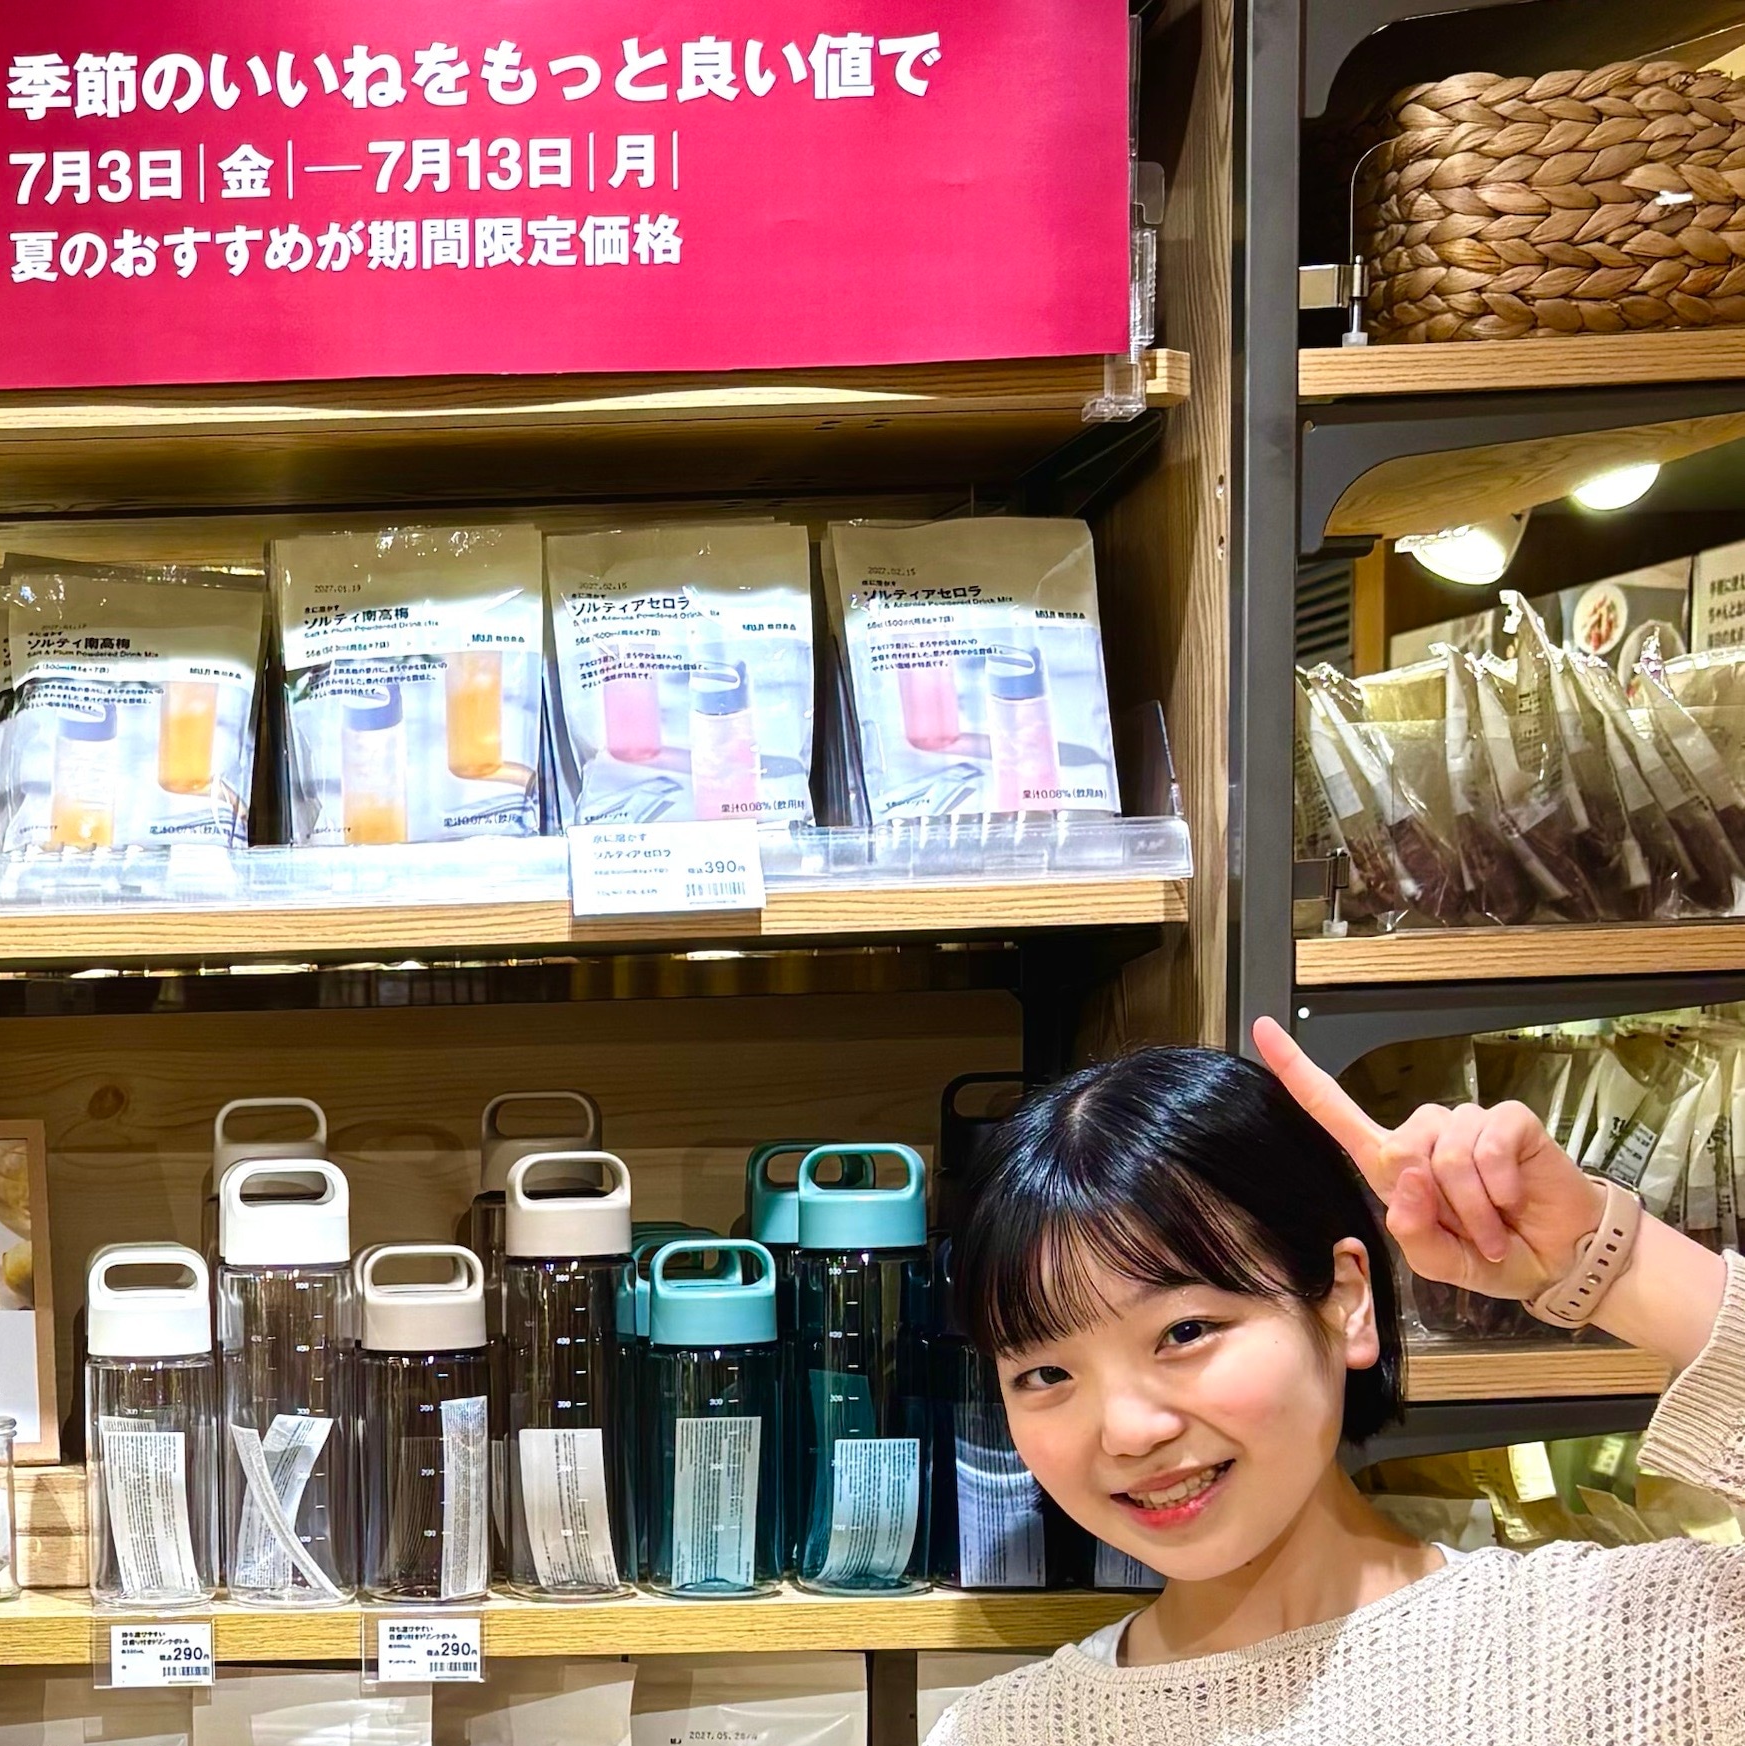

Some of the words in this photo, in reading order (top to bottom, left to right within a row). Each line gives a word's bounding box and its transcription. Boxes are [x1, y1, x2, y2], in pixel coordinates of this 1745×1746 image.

[6, 30, 943, 122] 季節のいいねをもっと良い値で
[9, 212, 684, 282] 夏のおすすめが期間限定価格
[572, 596, 690, 616] ソルティアセロラ
[304, 608, 409, 629] ソルティ南高梅
[27, 637, 130, 650] ソルティ南高梅
